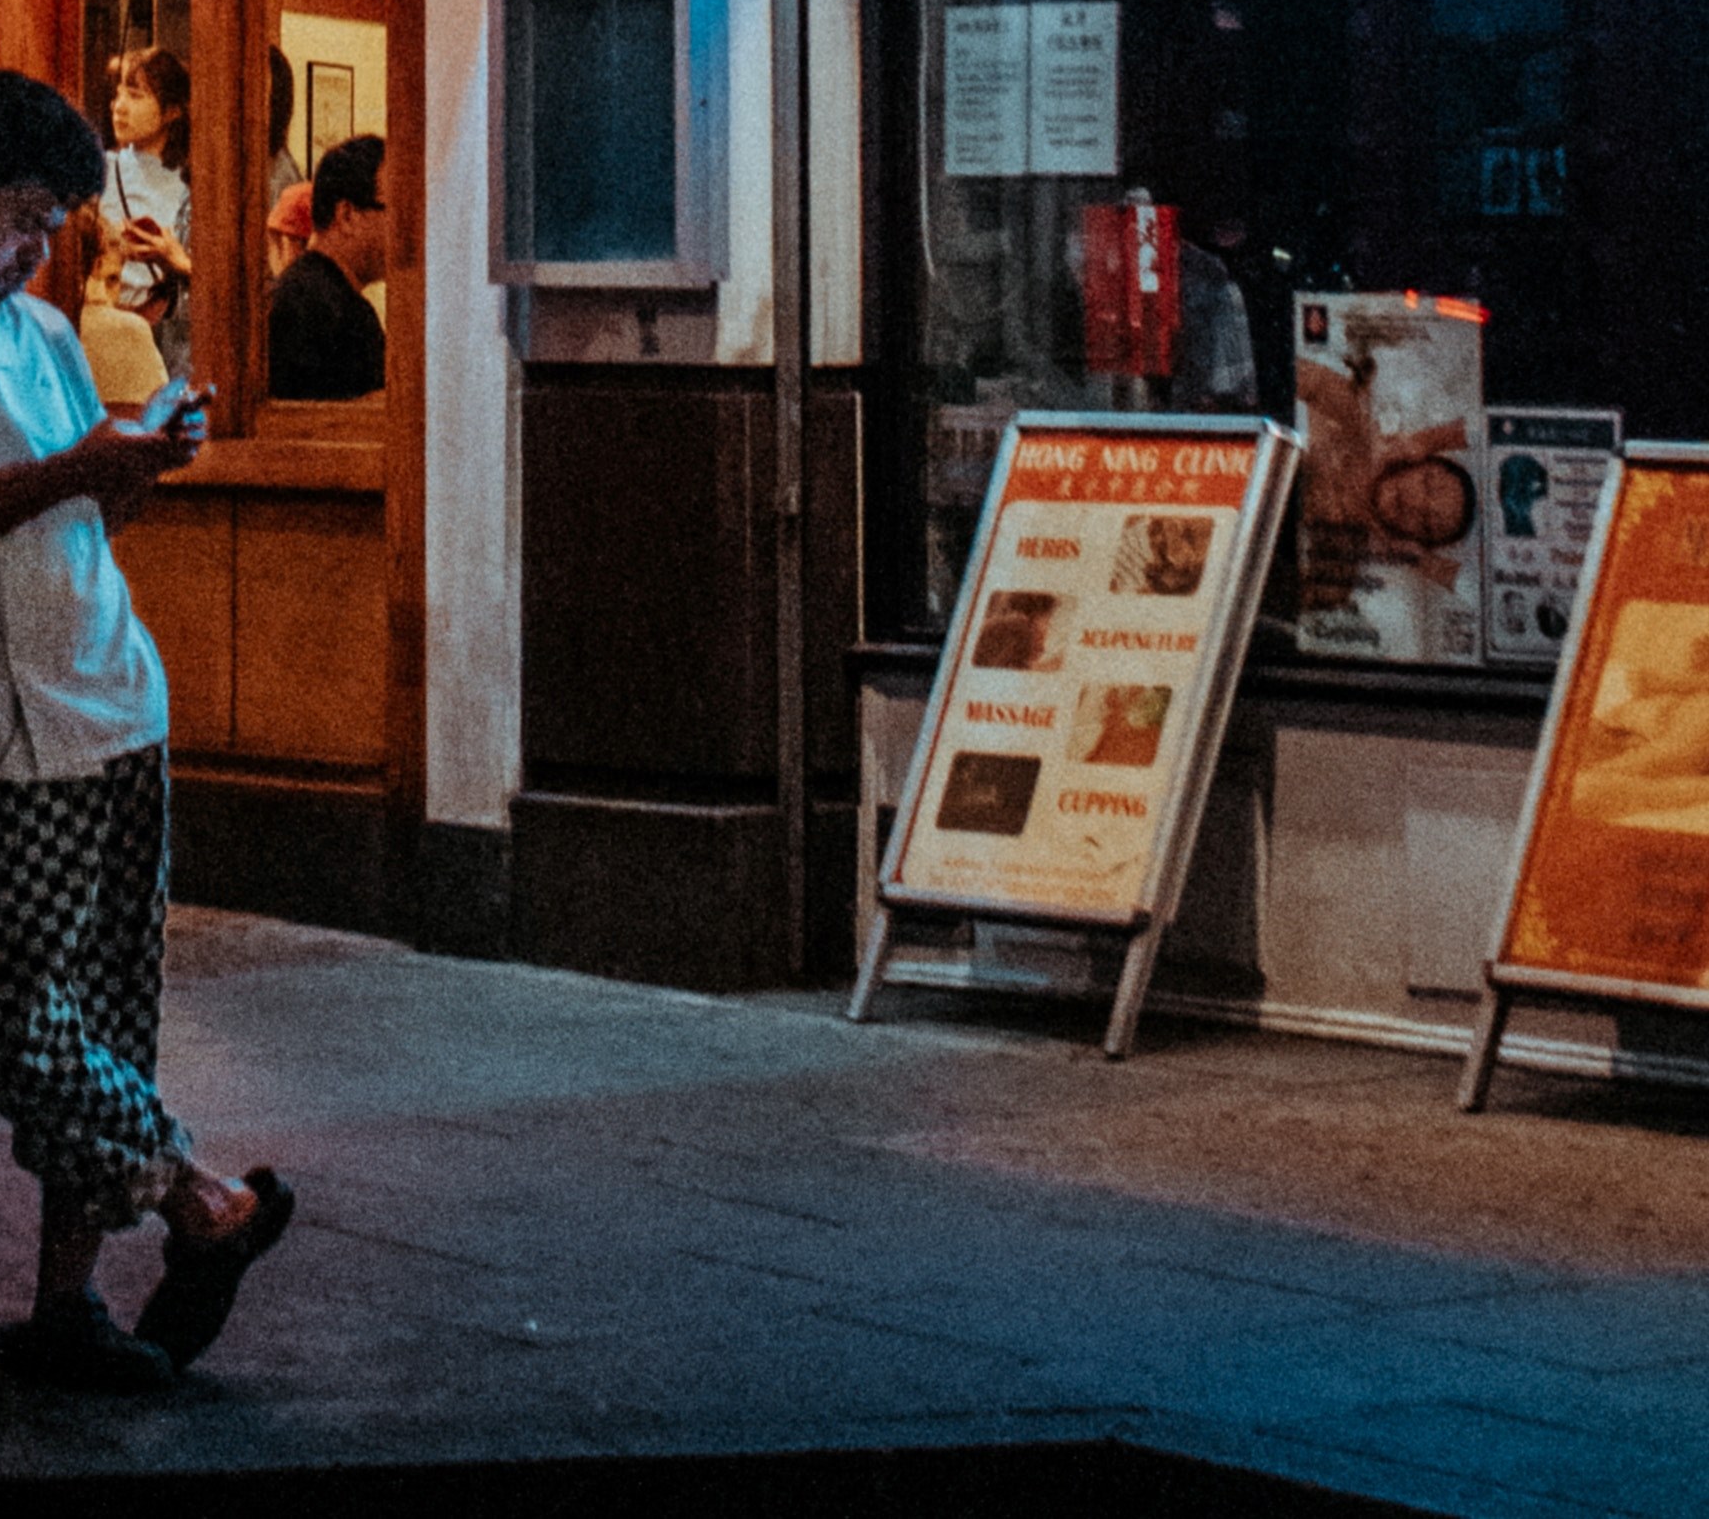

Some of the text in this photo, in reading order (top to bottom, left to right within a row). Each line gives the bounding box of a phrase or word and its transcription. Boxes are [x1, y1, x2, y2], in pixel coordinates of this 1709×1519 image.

[1015, 442, 1256, 477] HONG NING CLINIC
[1016, 537, 1081, 560] HERBS
[1079, 629, 1198, 652] ACUPUNCTURE
[965, 700, 1056, 729] MASSAGE
[1057, 789, 1148, 819] CUPPING
